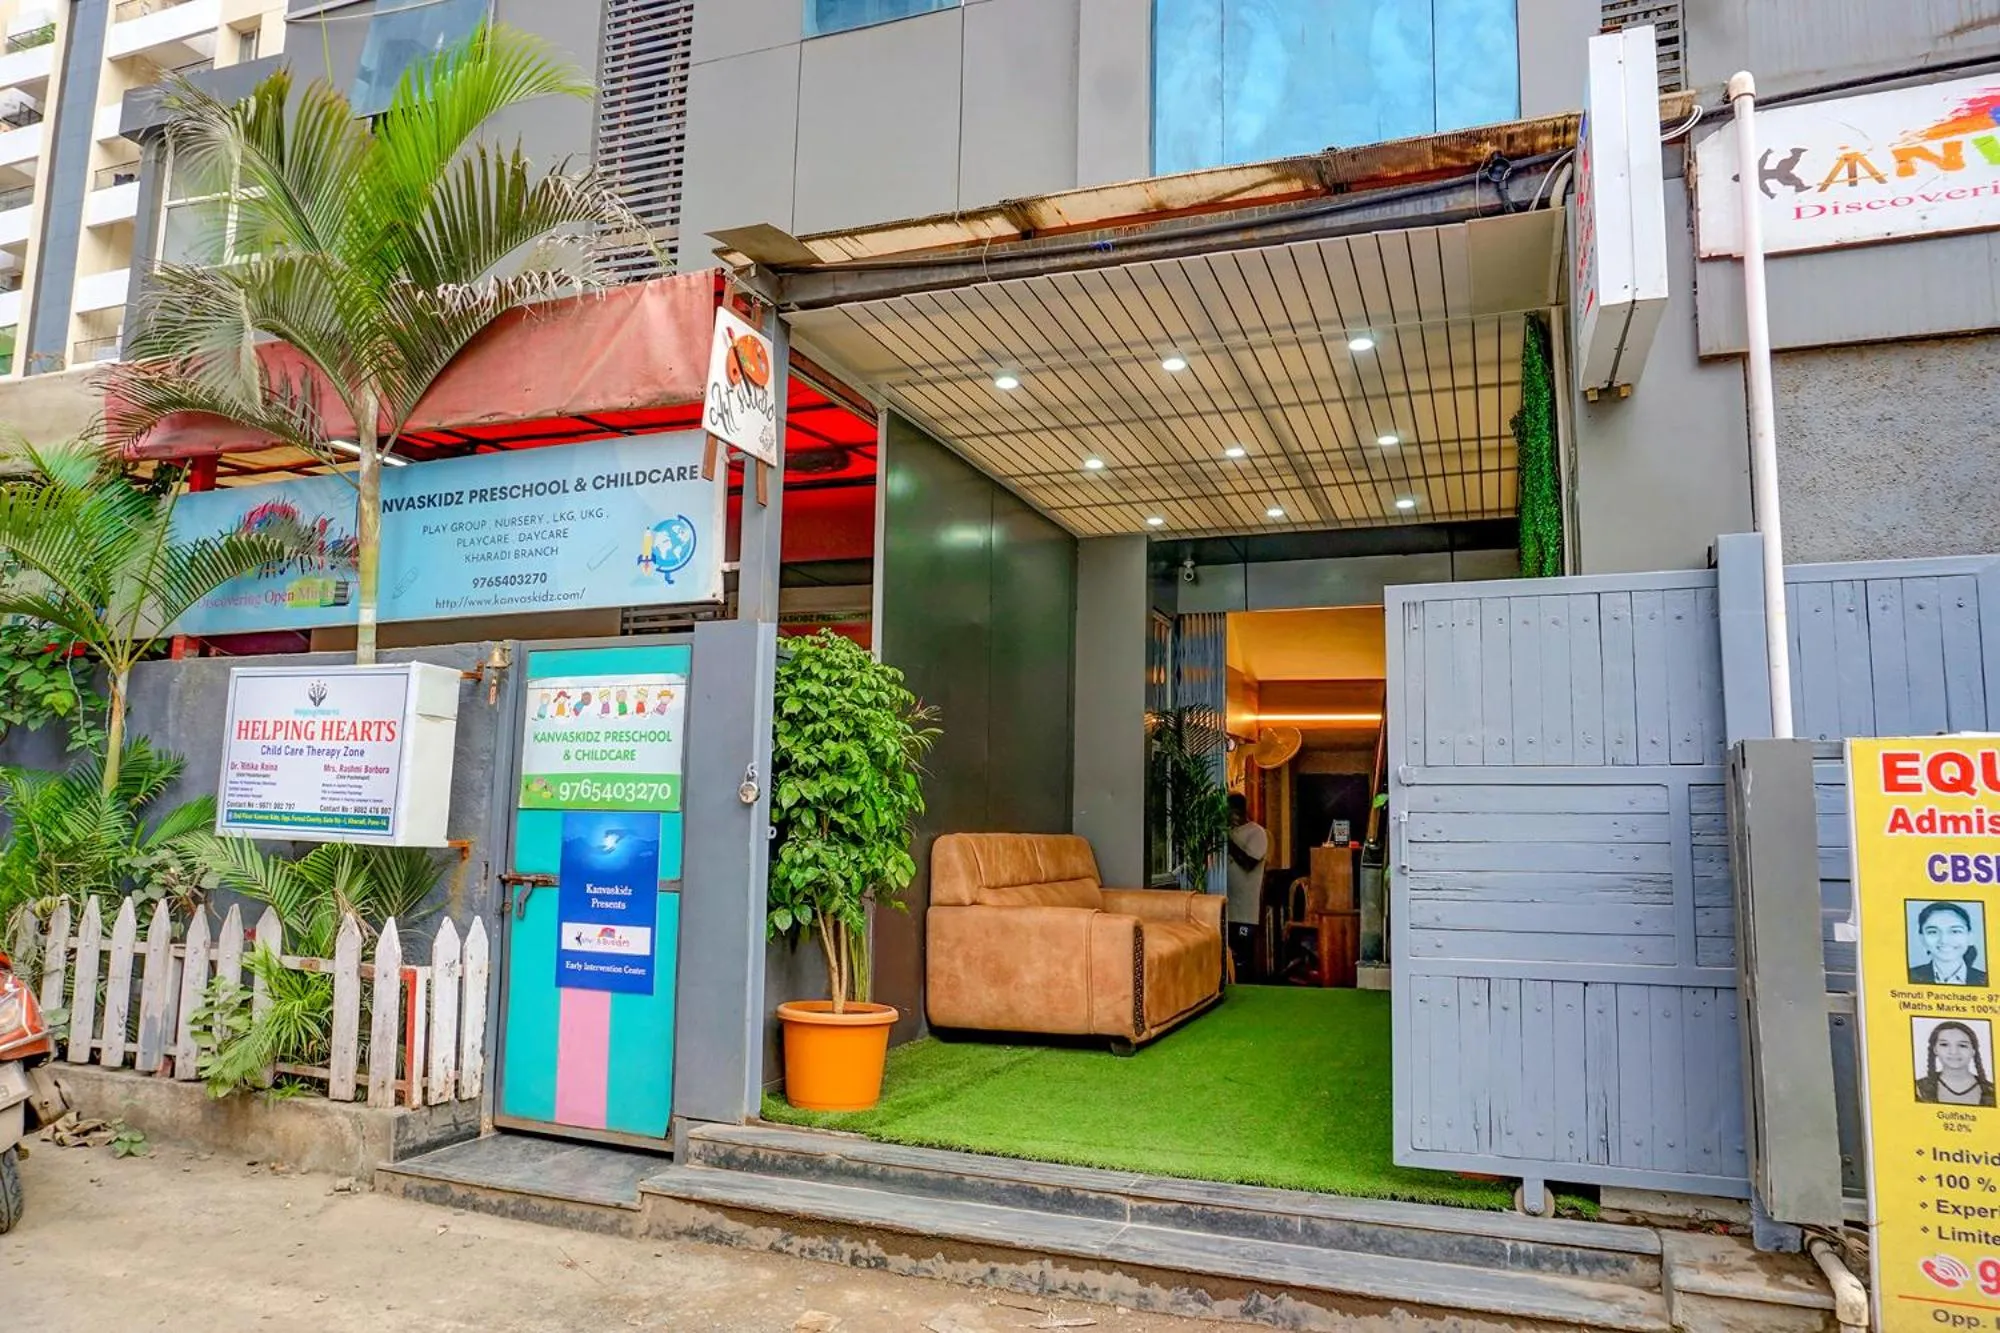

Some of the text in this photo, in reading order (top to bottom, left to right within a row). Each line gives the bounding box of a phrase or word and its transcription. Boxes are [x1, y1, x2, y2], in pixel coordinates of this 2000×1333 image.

[1792, 180, 2000, 220] Discoveri
[381, 465, 698, 514] NVASKIDZ PRESCHOOL & CHILDCARE
[422, 523, 446, 535] PLAY
[518, 528, 569, 543] DAYCARE
[464, 546, 559, 564] KHARADI BRANCH
[472, 572, 548, 589] 9765403270
[264, 589, 295, 605] Open
[435, 587, 586, 610] http://www.kanvaskidz.com/
[236, 719, 397, 742] HELPING HEARTS
[533, 730, 673, 743] KANVASKIDZ PRESCHOOL
[261, 744, 365, 760] Child Care Therapy Zone
[563, 749, 637, 761] & CHILDCARE
[230, 761, 240, 771] Dr.
[559, 778, 671, 804] 9765403270
[226, 800, 247, 809] Contact
[320, 805, 340, 813] Contact
[1928, 854, 2000, 883] CBS
[586, 883, 633, 896] Kanvaskidz
[591, 897, 627, 910] Presents
[565, 960, 583, 972] Early
[583, 962, 623, 974] Intervention
[1890, 990, 1924, 1000] Smruti
[1927, 991, 1978, 1002] Panchade
[1899, 1001, 1933, 1011] (Maths
[1936, 1003, 1968, 1013] Marks
[1936, 1111, 1977, 1122] Gulfisha
[1932, 1147, 2000, 1167] Individ
[1935, 1173, 1997, 1193] 100 %
[1933, 1309, 1987, 1330] Opp.
